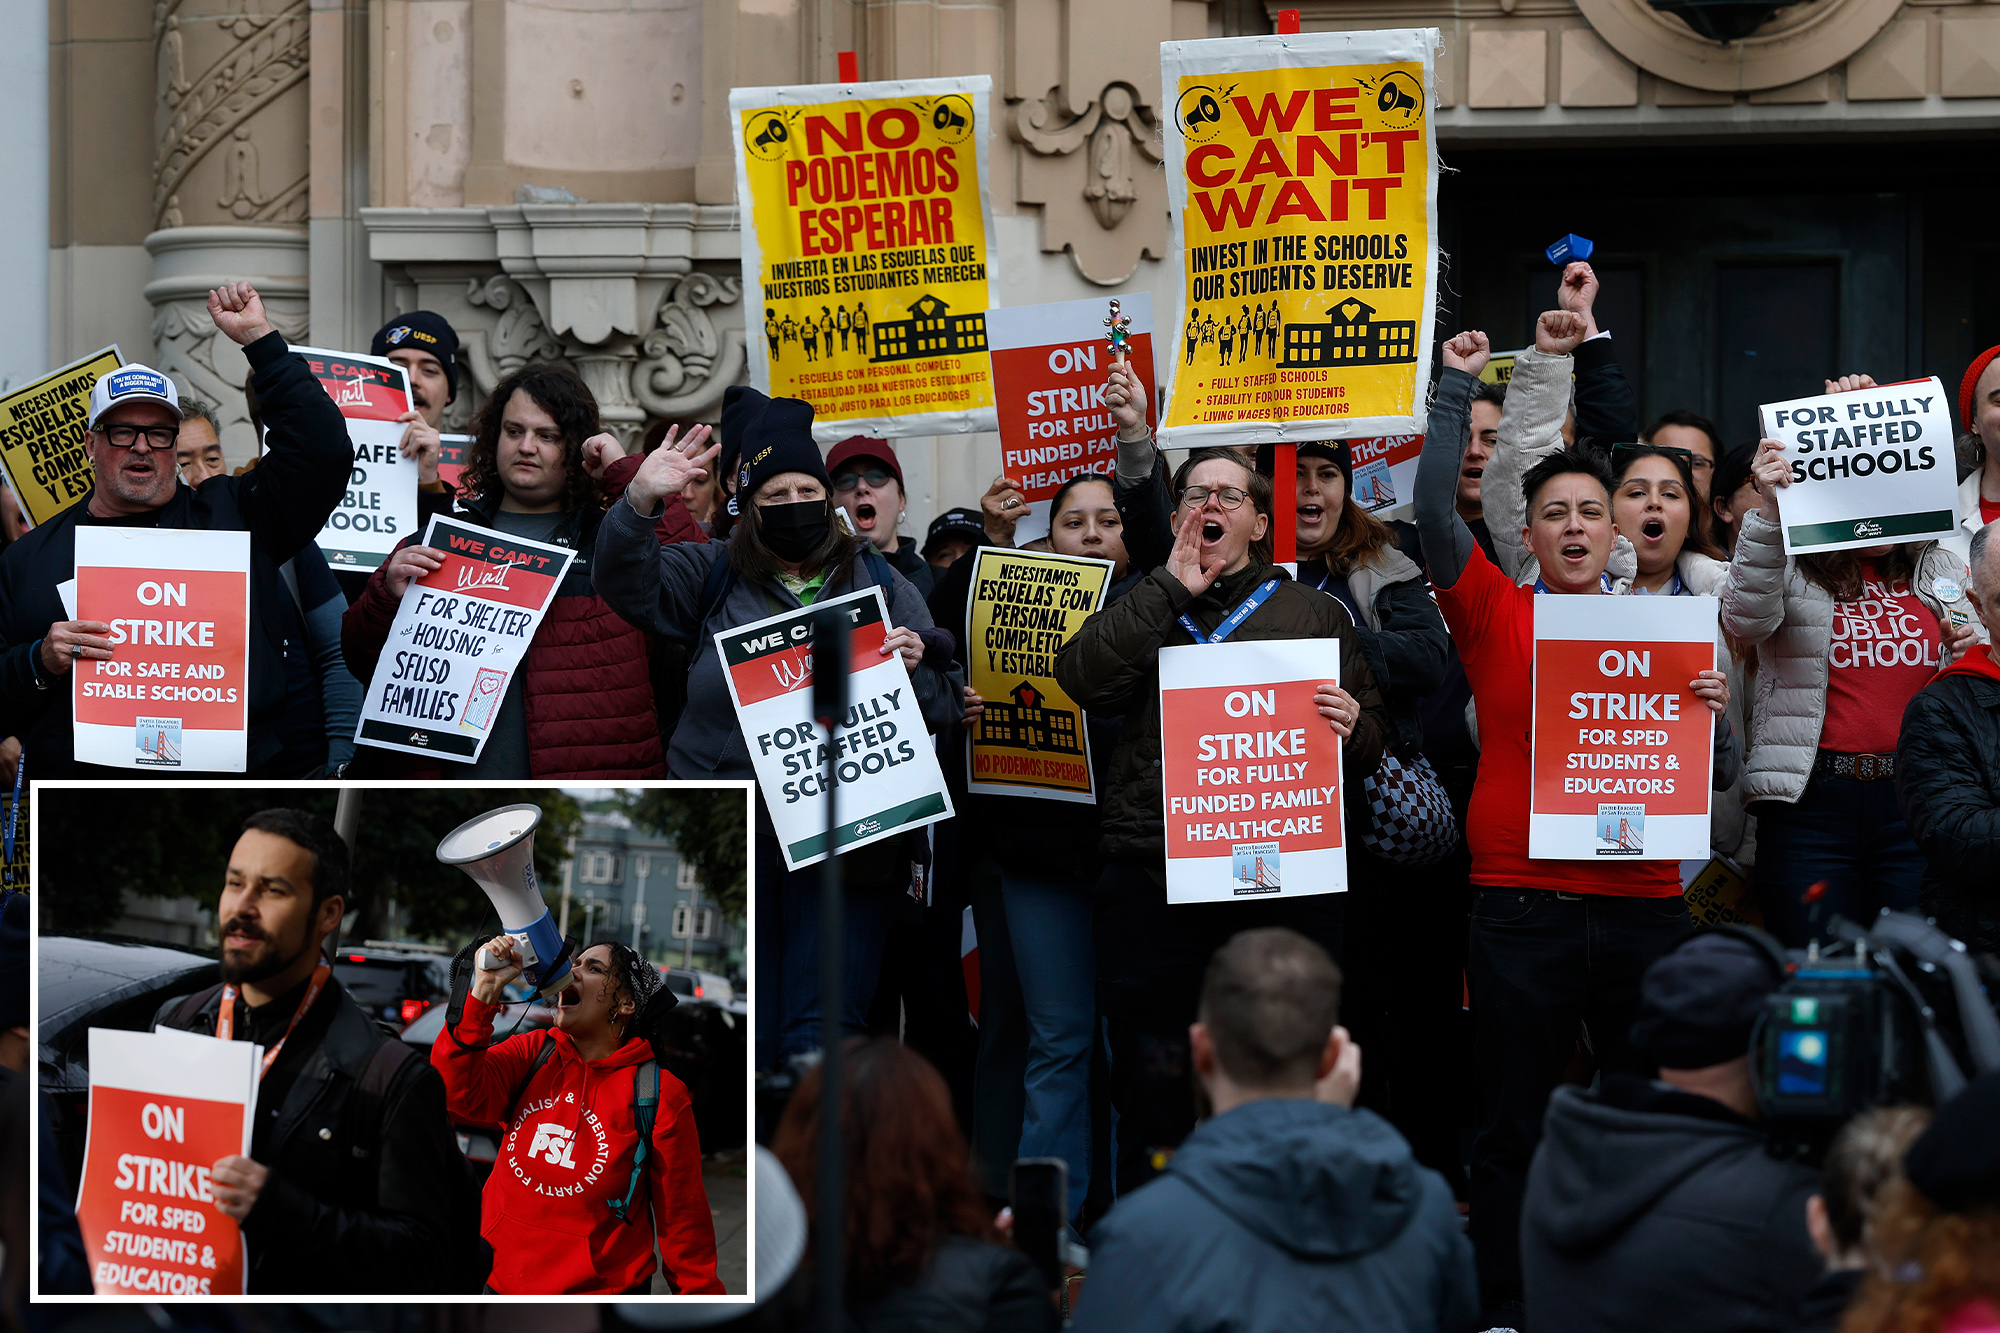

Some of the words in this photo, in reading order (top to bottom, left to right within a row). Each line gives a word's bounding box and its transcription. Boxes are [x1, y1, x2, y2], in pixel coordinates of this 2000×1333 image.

[1230, 86, 1363, 137] WE
[805, 108, 920, 156] NO
[1186, 130, 1419, 188] CAN'T
[786, 146, 959, 206] PODEMOS
[1193, 177, 1402, 233] WAIT
[799, 198, 954, 257] ESPERAR
[772, 259, 828, 280] INVIERTA
[832, 257, 849, 274] EN
[853, 254, 878, 272] LAS
[882, 248, 946, 270] ESCUELAS
[951, 245, 976, 264] QUE
[1192, 242, 1247, 274] INVEST
[1253, 238, 1268, 264] IN
[1272, 236, 1307, 262] THE
[1314, 234, 1408, 261] SCHOOLS
[764, 278, 830, 300] NUESTROS
[834, 269, 919, 294] ESTUDIANTES
[924, 264, 986, 284] MERECEN
[1193, 274, 1224, 302] OUR
[1230, 264, 1316, 297] STUDENTS
[1324, 263, 1413, 290] DESERVE
[414, 331, 438, 344] UESF
[308, 360, 324, 374] E
[799, 368, 844, 385] ESCUELAS
[846, 368, 865, 380] CON
[868, 364, 912, 378] PERSONAL
[916, 359, 961, 373] COMPLETO
[1048, 345, 1097, 374] ON
[800, 386, 856, 400] ESTABILIDAD
[858, 383, 880, 395] PARA
[882, 378, 928, 392] NUESTROS
[930, 372, 987, 387] ESTUDIANTES
[1211, 376, 1240, 390] FULLY
[1243, 373, 1277, 388] STAFFED
[1280, 370, 1328, 384] SCHOOLS
[8, 372, 97, 422] NECESITAMOS
[814, 403, 836, 414] ELDO
[840, 400, 867, 412] JUSTO
[870, 397, 892, 409] PARA
[894, 396, 912, 406] LOS
[914, 389, 970, 404] EDUCADORES
[1027, 382, 1109, 416] STRIK
[1206, 392, 1252, 406] STABILITY
[1256, 391, 1272, 404] FOR
[1274, 389, 1292, 402] OUR
[1296, 386, 1346, 400] STUDENTS
[0, 398, 86, 452] ESCUELAS
[1203, 408, 1234, 422] LIVING
[1237, 408, 1270, 420] WAGES
[1273, 406, 1290, 418] FOR
[1292, 402, 1350, 416] EDUCATORS
[1775, 406, 1835, 428] FOR
[1847, 396, 1934, 421] FULLY
[26, 417, 89, 464] PERSO
[1028, 420, 1070, 440] FOR
[1073, 415, 1118, 434] FULL
[1797, 420, 1923, 454] STAFFED
[354, 443, 397, 464] AFE
[752, 446, 773, 466] UESF
[1006, 442, 1082, 468] FUNDED
[1352, 436, 1416, 465] THCARE
[1793, 446, 1936, 484] SCHOOLS
[32, 446, 88, 486] COMP
[1022, 458, 1116, 491] HEALTHCA
[44, 484, 60, 504] Y
[338, 490, 381, 510] BLE
[325, 512, 396, 534] OOLS
[450, 534, 486, 554] WE
[489, 546, 550, 570] CAN'T
[1000, 564, 1080, 588] NECESITAMOS
[136, 581, 187, 607] ON
[978, 579, 1056, 608] ESCUELAS
[1060, 588, 1094, 612] CON
[415, 593, 458, 620] FOR
[458, 601, 532, 638] SHELTER
[991, 604, 1067, 632] PERSONAL
[1832, 614, 1922, 640] UBLIC
[109, 618, 215, 647] STRIKE
[412, 622, 486, 658] HOUSING
[742, 632, 784, 654] WE
[986, 627, 1062, 654] COMPLETO
[392, 651, 450, 684] SFUSD
[988, 650, 996, 672] Y
[1002, 652, 1056, 678] ESTABL
[1598, 650, 1650, 678] ON
[1828, 638, 1944, 668] CHOOL
[96, 661, 132, 678] FOR
[136, 662, 180, 678] SAFE
[184, 664, 226, 680] AND
[82, 682, 146, 700] STABLE
[150, 685, 238, 703] SCHOOLS
[380, 684, 459, 722] FAMILIES
[1224, 690, 1276, 718] ON
[1568, 692, 1680, 722] STRIKE
[757, 720, 818, 756] FOR
[840, 688, 902, 729] ULLY
[782, 720, 897, 776] STAFFED
[1197, 728, 1306, 762] STRIKE
[1578, 729, 1617, 746] FOR
[1622, 730, 1669, 746] SPED
[782, 740, 914, 804] SCHOOLS
[976, 754, 991, 774] NO
[993, 754, 1042, 778] PODEMOS
[1044, 760, 1087, 783] ESPERAR
[1197, 766, 1242, 786] FOR
[1246, 761, 1308, 784] FULLY
[1566, 753, 1660, 770] STUDENTS
[1665, 754, 1680, 770] &
[1170, 792, 1256, 814] FUNDED
[1261, 785, 1336, 810] FAMILY
[1564, 778, 1676, 794] EDUCATORS
[1186, 814, 1323, 842] HEALTHCARE
[564, 1092, 574, 1104] &
[142, 1102, 184, 1144] ON
[528, 1130, 577, 1170] PSL
[114, 1153, 214, 1204] STRIKE
[509, 1156, 532, 1186] FOR
[535, 1182, 584, 1198] PARTY
[121, 1200, 158, 1226] FOR
[161, 1206, 206, 1234] SPED
[103, 1230, 198, 1266] STUDENTS
[200, 1245, 216, 1270] &
[94, 1262, 212, 1296] EDUCATORS
